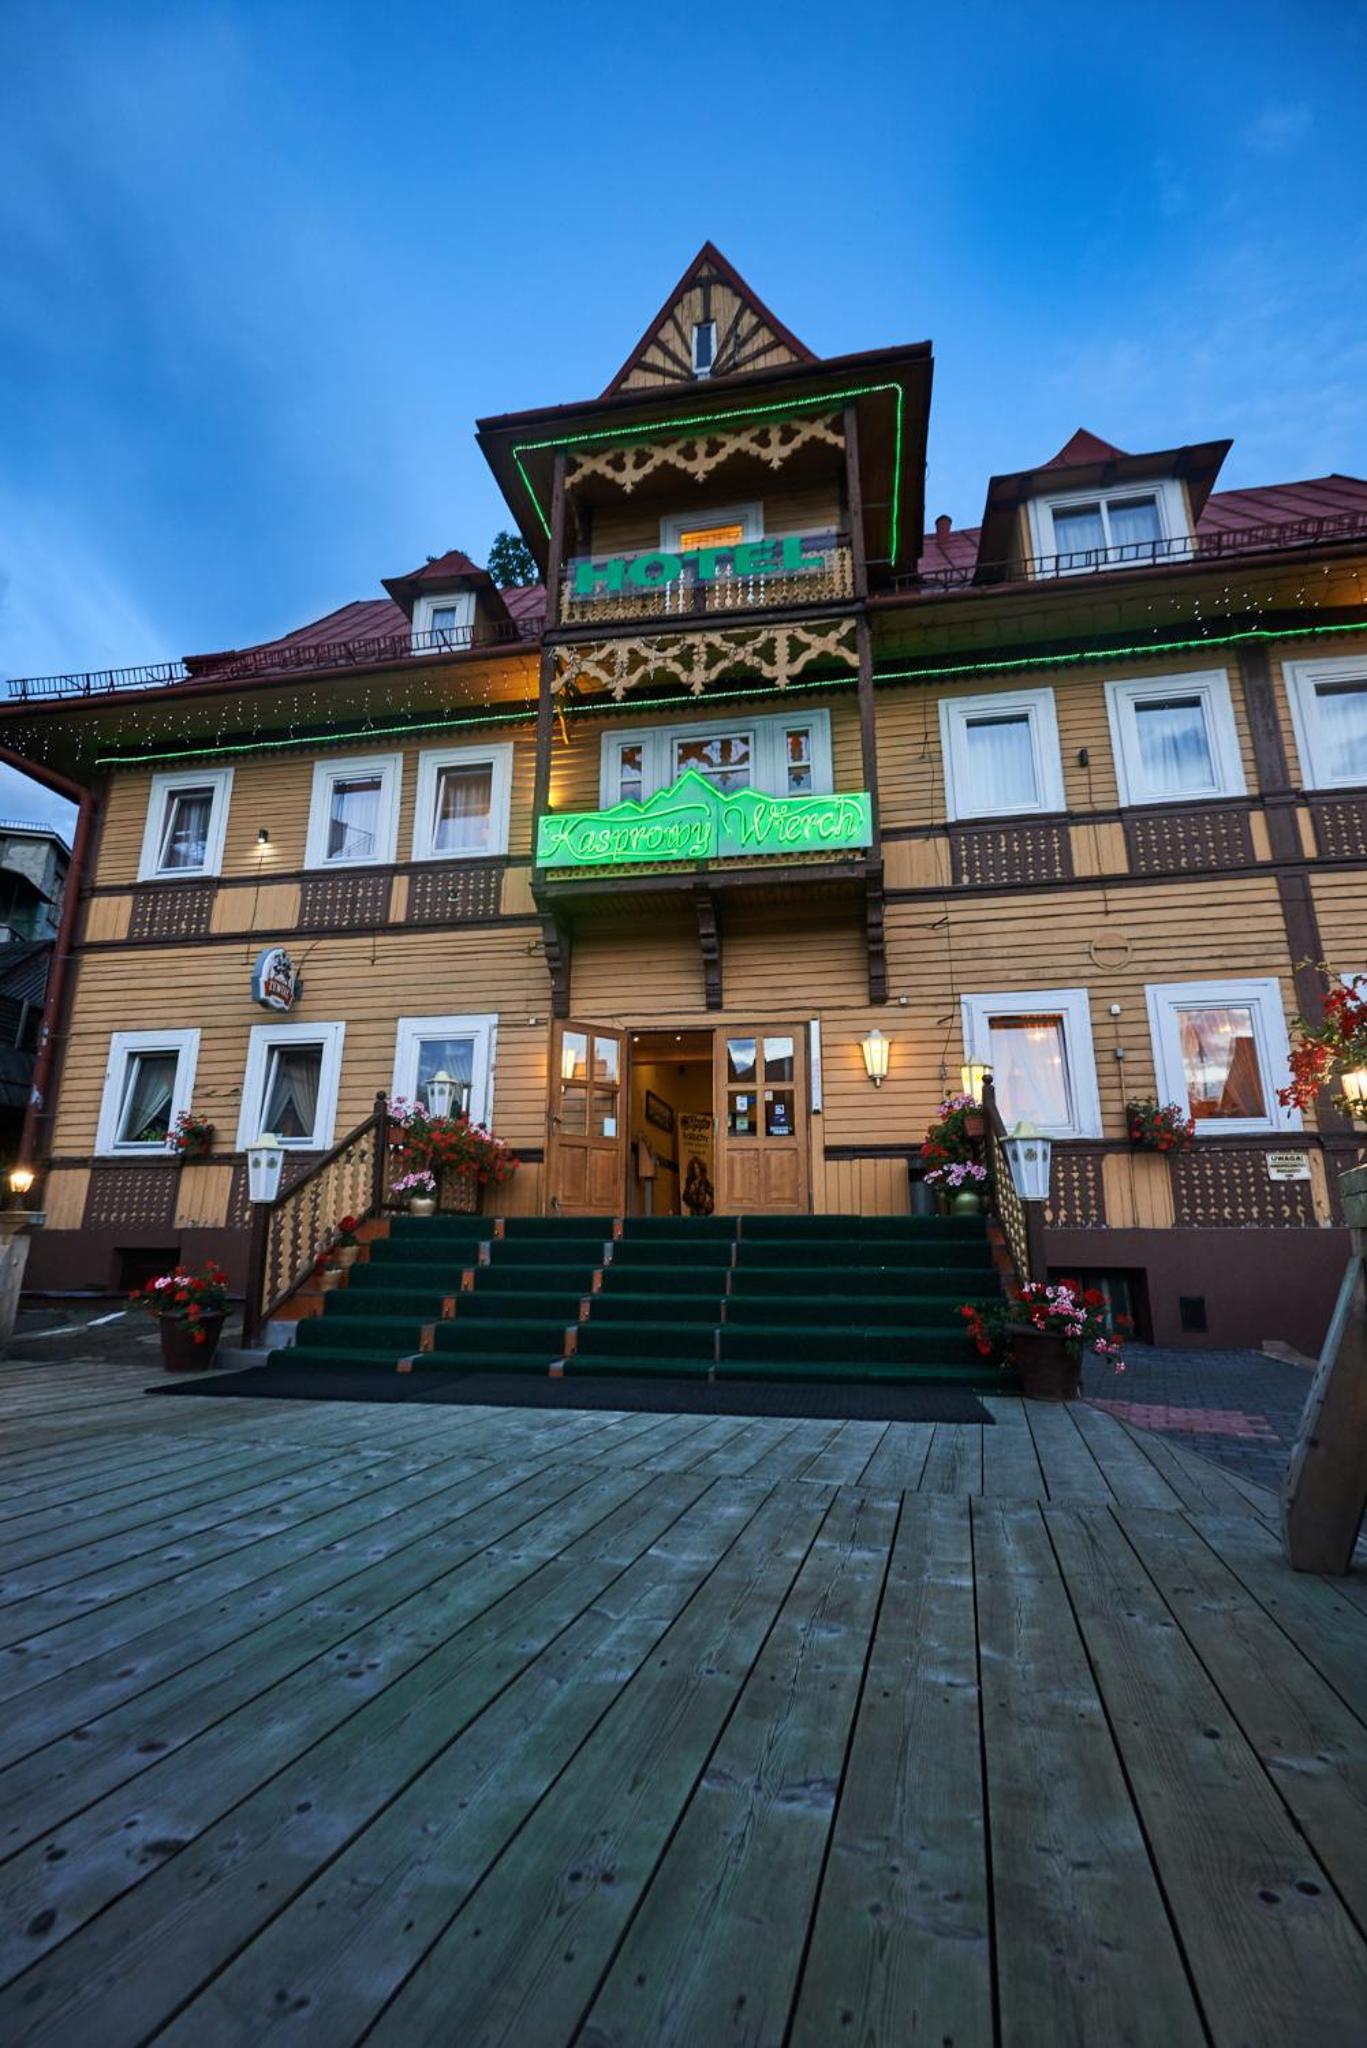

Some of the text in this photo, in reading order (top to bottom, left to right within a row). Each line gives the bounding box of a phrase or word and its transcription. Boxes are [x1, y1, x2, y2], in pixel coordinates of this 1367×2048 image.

[575, 536, 825, 594] HOTEL
[538, 796, 864, 862] Kasprowy Wierch
